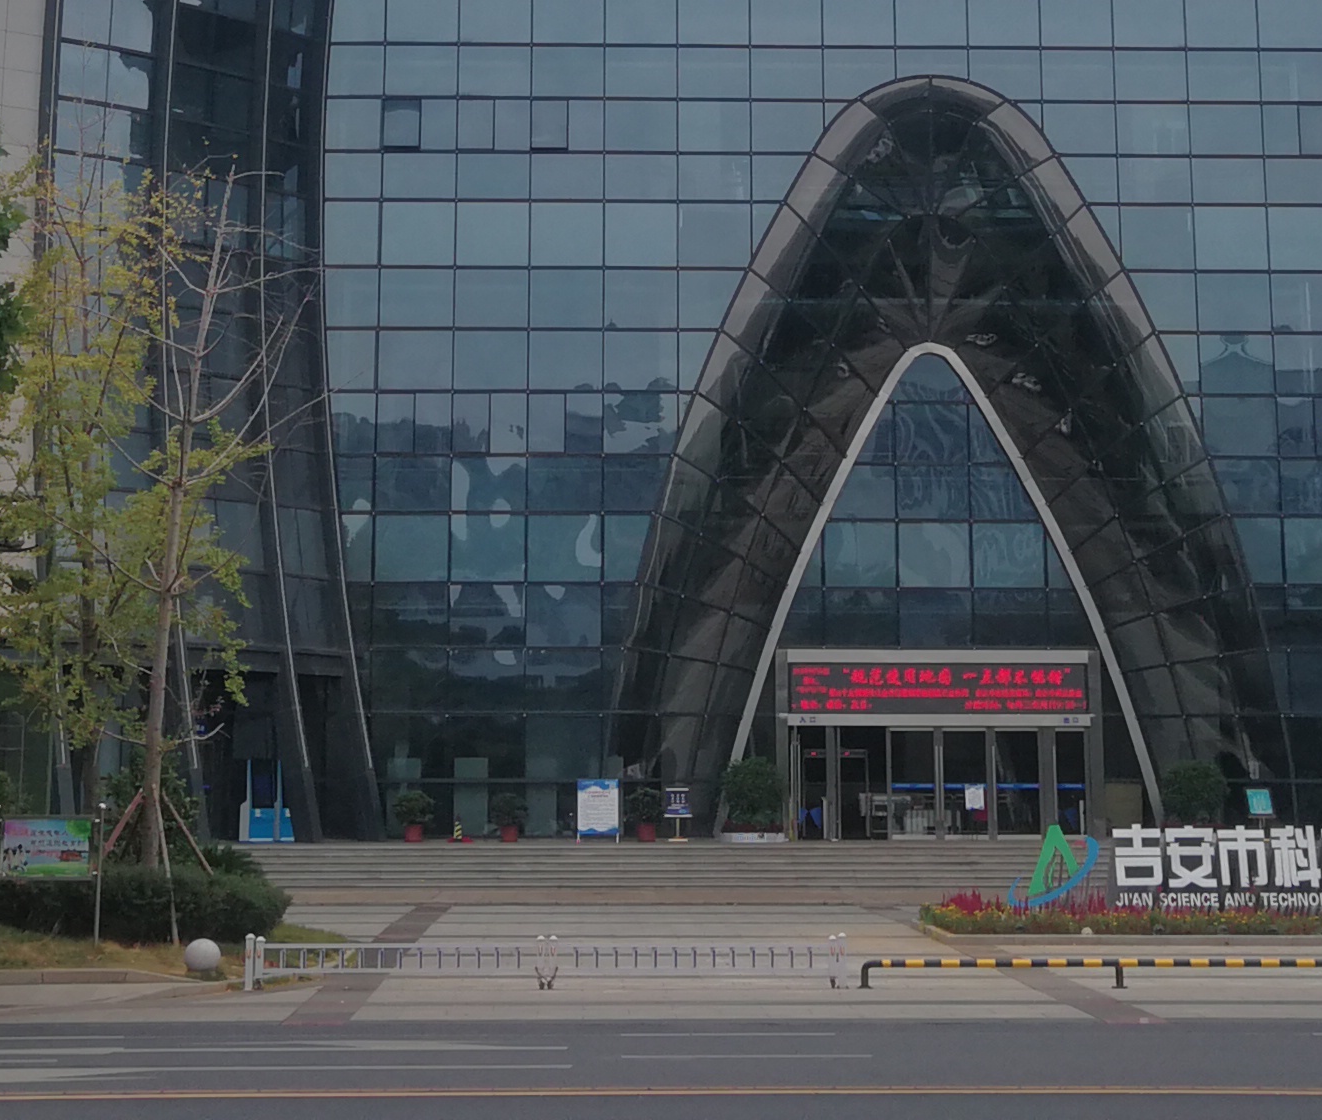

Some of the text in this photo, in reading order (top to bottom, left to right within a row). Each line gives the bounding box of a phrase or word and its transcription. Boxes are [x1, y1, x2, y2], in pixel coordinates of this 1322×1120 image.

[1115, 892, 1154, 906] JI'AN
[1160, 892, 1220, 906] SCIENCE
[1224, 892, 1256, 906] AND
